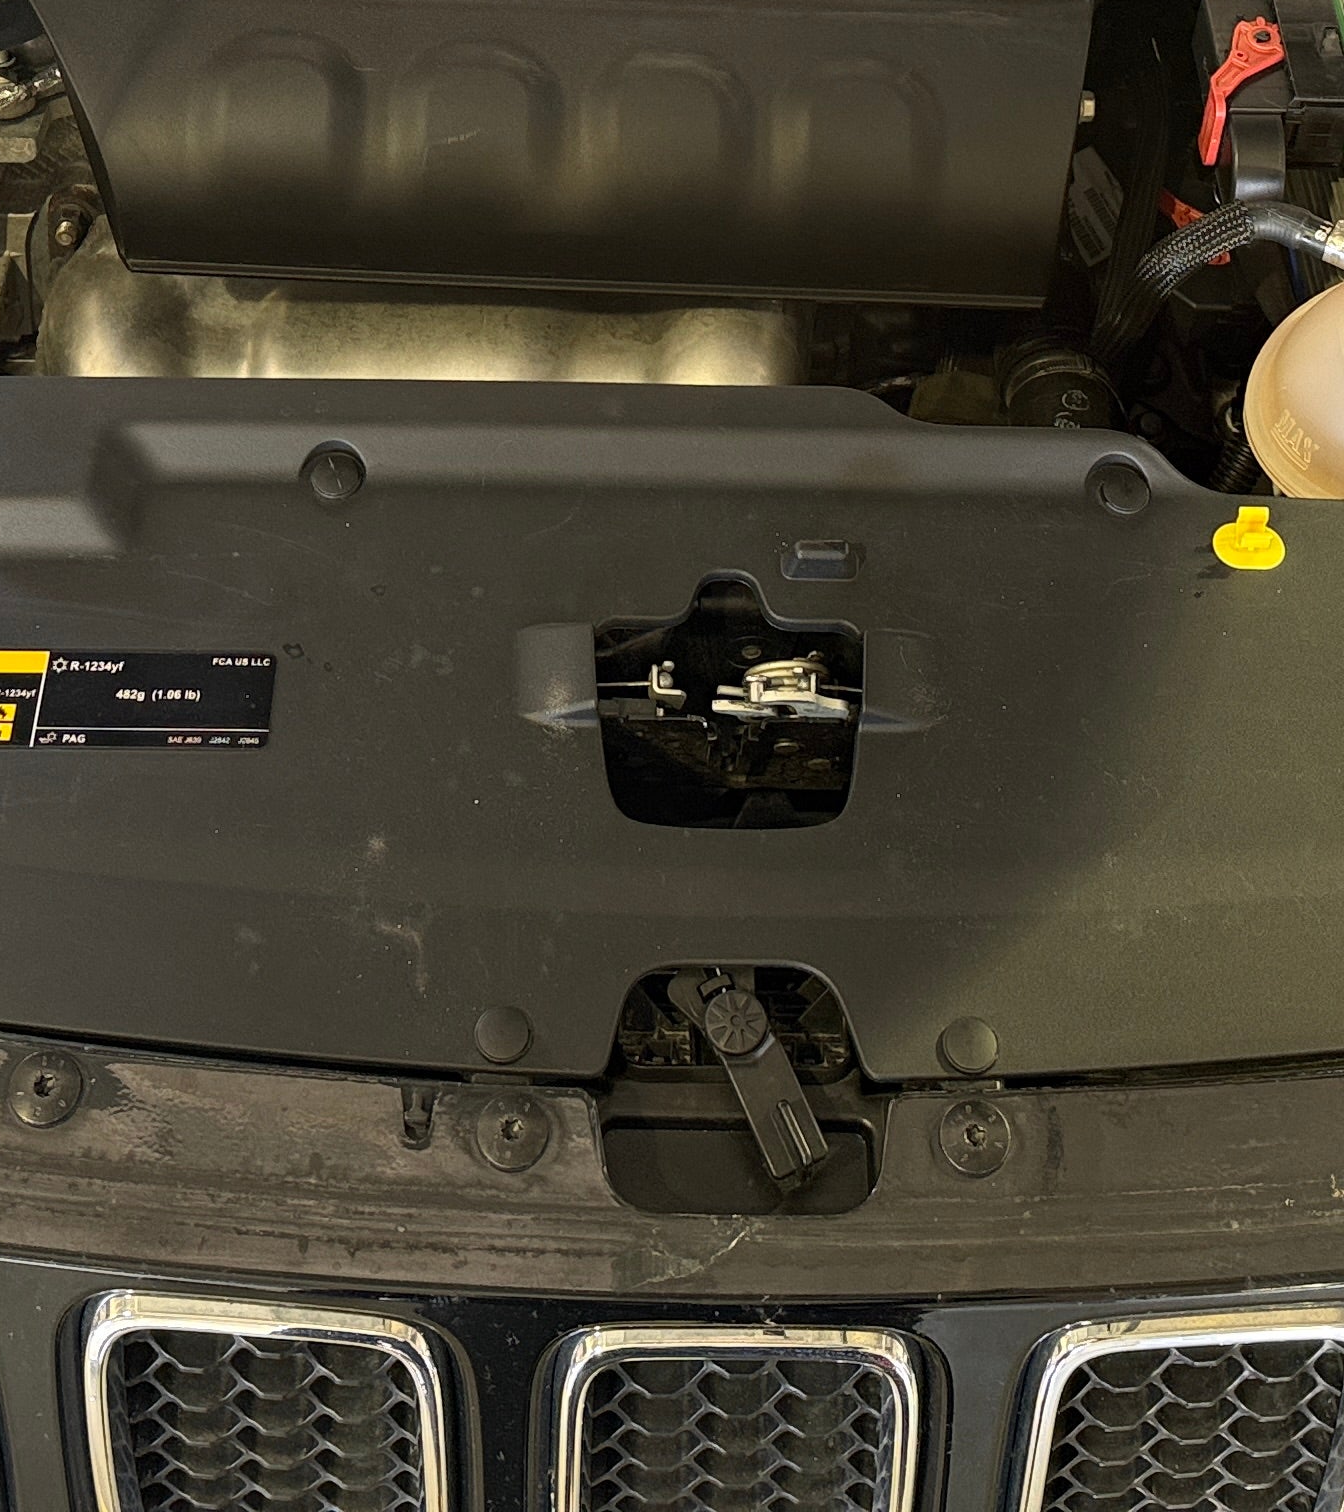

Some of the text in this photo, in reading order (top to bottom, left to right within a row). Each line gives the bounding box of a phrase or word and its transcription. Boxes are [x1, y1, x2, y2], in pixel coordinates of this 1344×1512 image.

[1274, 408, 1313, 464] MAX
[69, 661, 125, 674] R-1234yf
[212, 657, 271, 667] FCA US LLC
[115, 689, 201, 702] 482g (1.06 lb)
[61, 734, 86, 744] PAG
